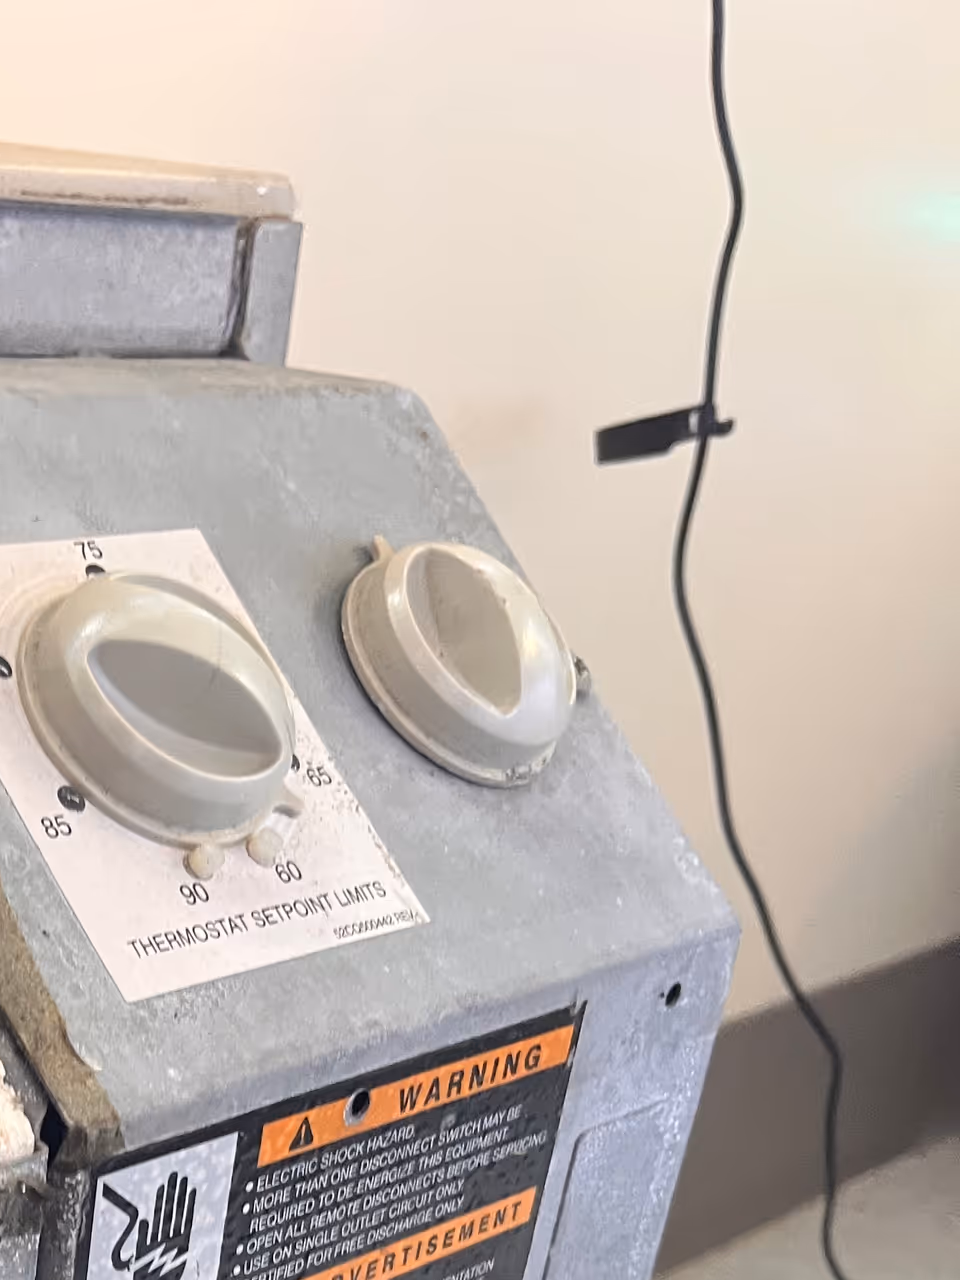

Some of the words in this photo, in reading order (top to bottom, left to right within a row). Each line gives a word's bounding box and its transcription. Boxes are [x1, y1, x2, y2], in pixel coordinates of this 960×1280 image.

[74, 541, 103, 560] 75
[306, 765, 332, 787] 65
[41, 815, 72, 839] 85
[179, 883, 209, 905] 90
[275, 860, 303, 883] 60
[127, 912, 249, 960] THERMOSTAT
[250, 893, 333, 929] SETPOINT
[333, 880, 387, 907] LIMITS
[398, 1044, 542, 1114] WARNING
[253, 1190, 291, 1214] MORE
[295, 1175, 328, 1202] THAN
[330, 1164, 358, 1185] ONE
[360, 1134, 436, 1166] DISCONNECT
[438, 1121, 481, 1146] SWITCH
[483, 1109, 507, 1129] MAY
[506, 1104, 523, 1121] BE
[256, 1157, 318, 1192] ELECTRIC
[320, 1142, 365, 1170] SHOCK
[246, 1228, 283, 1255] OPEN
[284, 1221, 307, 1240] ALL
[309, 1203, 360, 1231] REMOTE
[362, 1167, 445, 1205] DISCONNECTS
[446, 1154, 490, 1178] BEFORE
[491, 1129, 548, 1161] SERVICING
[249, 1198, 315, 1235] REQUIRED
[318, 1190, 335, 1208] TO
[336, 1161, 415, 1201] DE-ENERGIZE
[418, 1152, 443, 1169] THIS
[243, 1254, 271, 1275] USE
[272, 1247, 292, 1264] ON
[294, 1225, 339, 1255] SINGLE
[341, 1208, 387, 1237] OUTLET
[388, 1189, 434, 1219] CIRCUIT
[306, 1248, 333, 1269] FOR
[334, 1235, 365, 1256] FREE
[367, 1210, 432, 1243] DISCHARGE
